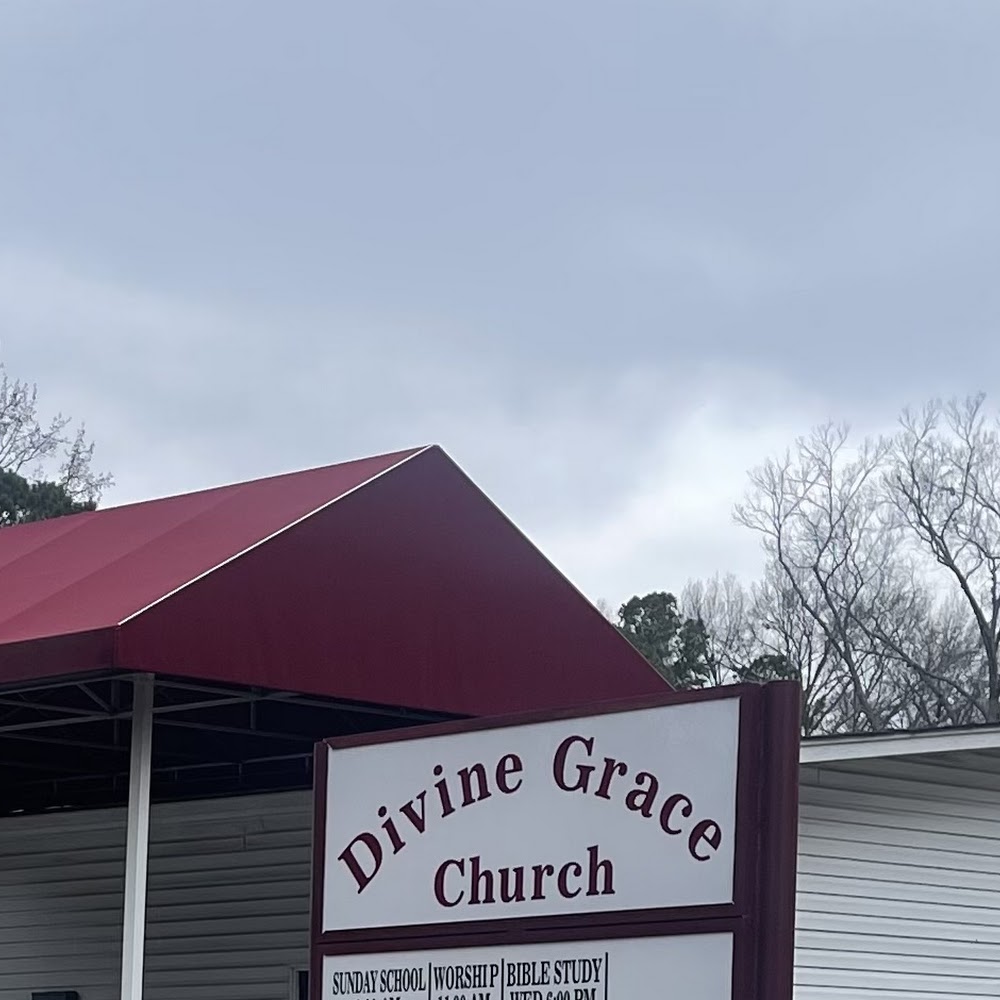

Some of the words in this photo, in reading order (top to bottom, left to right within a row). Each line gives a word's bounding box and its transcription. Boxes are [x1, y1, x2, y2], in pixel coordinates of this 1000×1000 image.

[337, 752, 524, 894] Divine
[552, 735, 722, 862] Grace
[433, 845, 615, 907] Church
[332, 969, 378, 996] SUNDAY
[379, 967, 426, 993] SCHOOL
[433, 963, 499, 991] WORSHIP
[506, 960, 550, 988] BIBLE
[553, 957, 602, 985] STUDY
